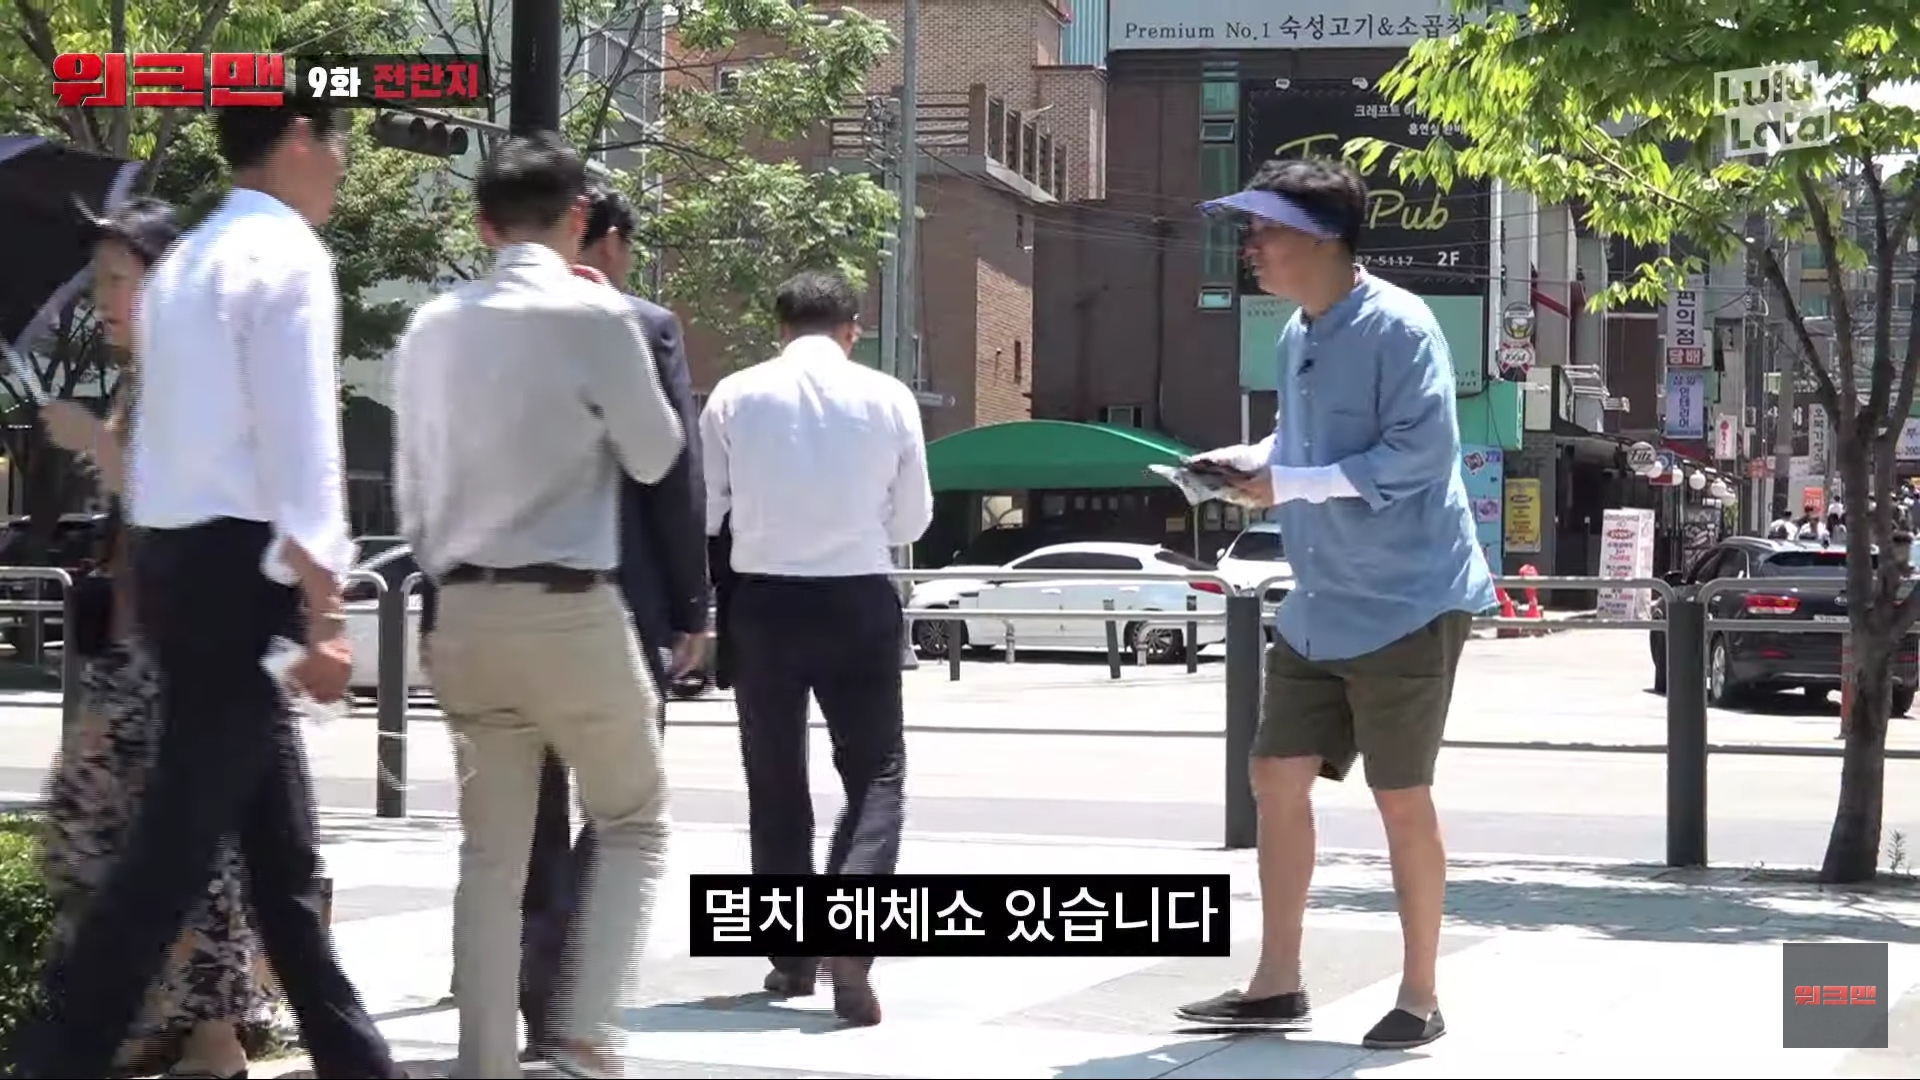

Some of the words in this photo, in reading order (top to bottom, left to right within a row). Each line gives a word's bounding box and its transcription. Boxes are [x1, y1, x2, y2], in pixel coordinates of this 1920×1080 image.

[1124, 21, 1215, 39] Premium
[1225, 21, 1270, 42] No.1
[1365, 189, 1450, 231] Pub
[1437, 250, 1460, 267] 2F
[1675, 290, 1696, 346] 편의점
